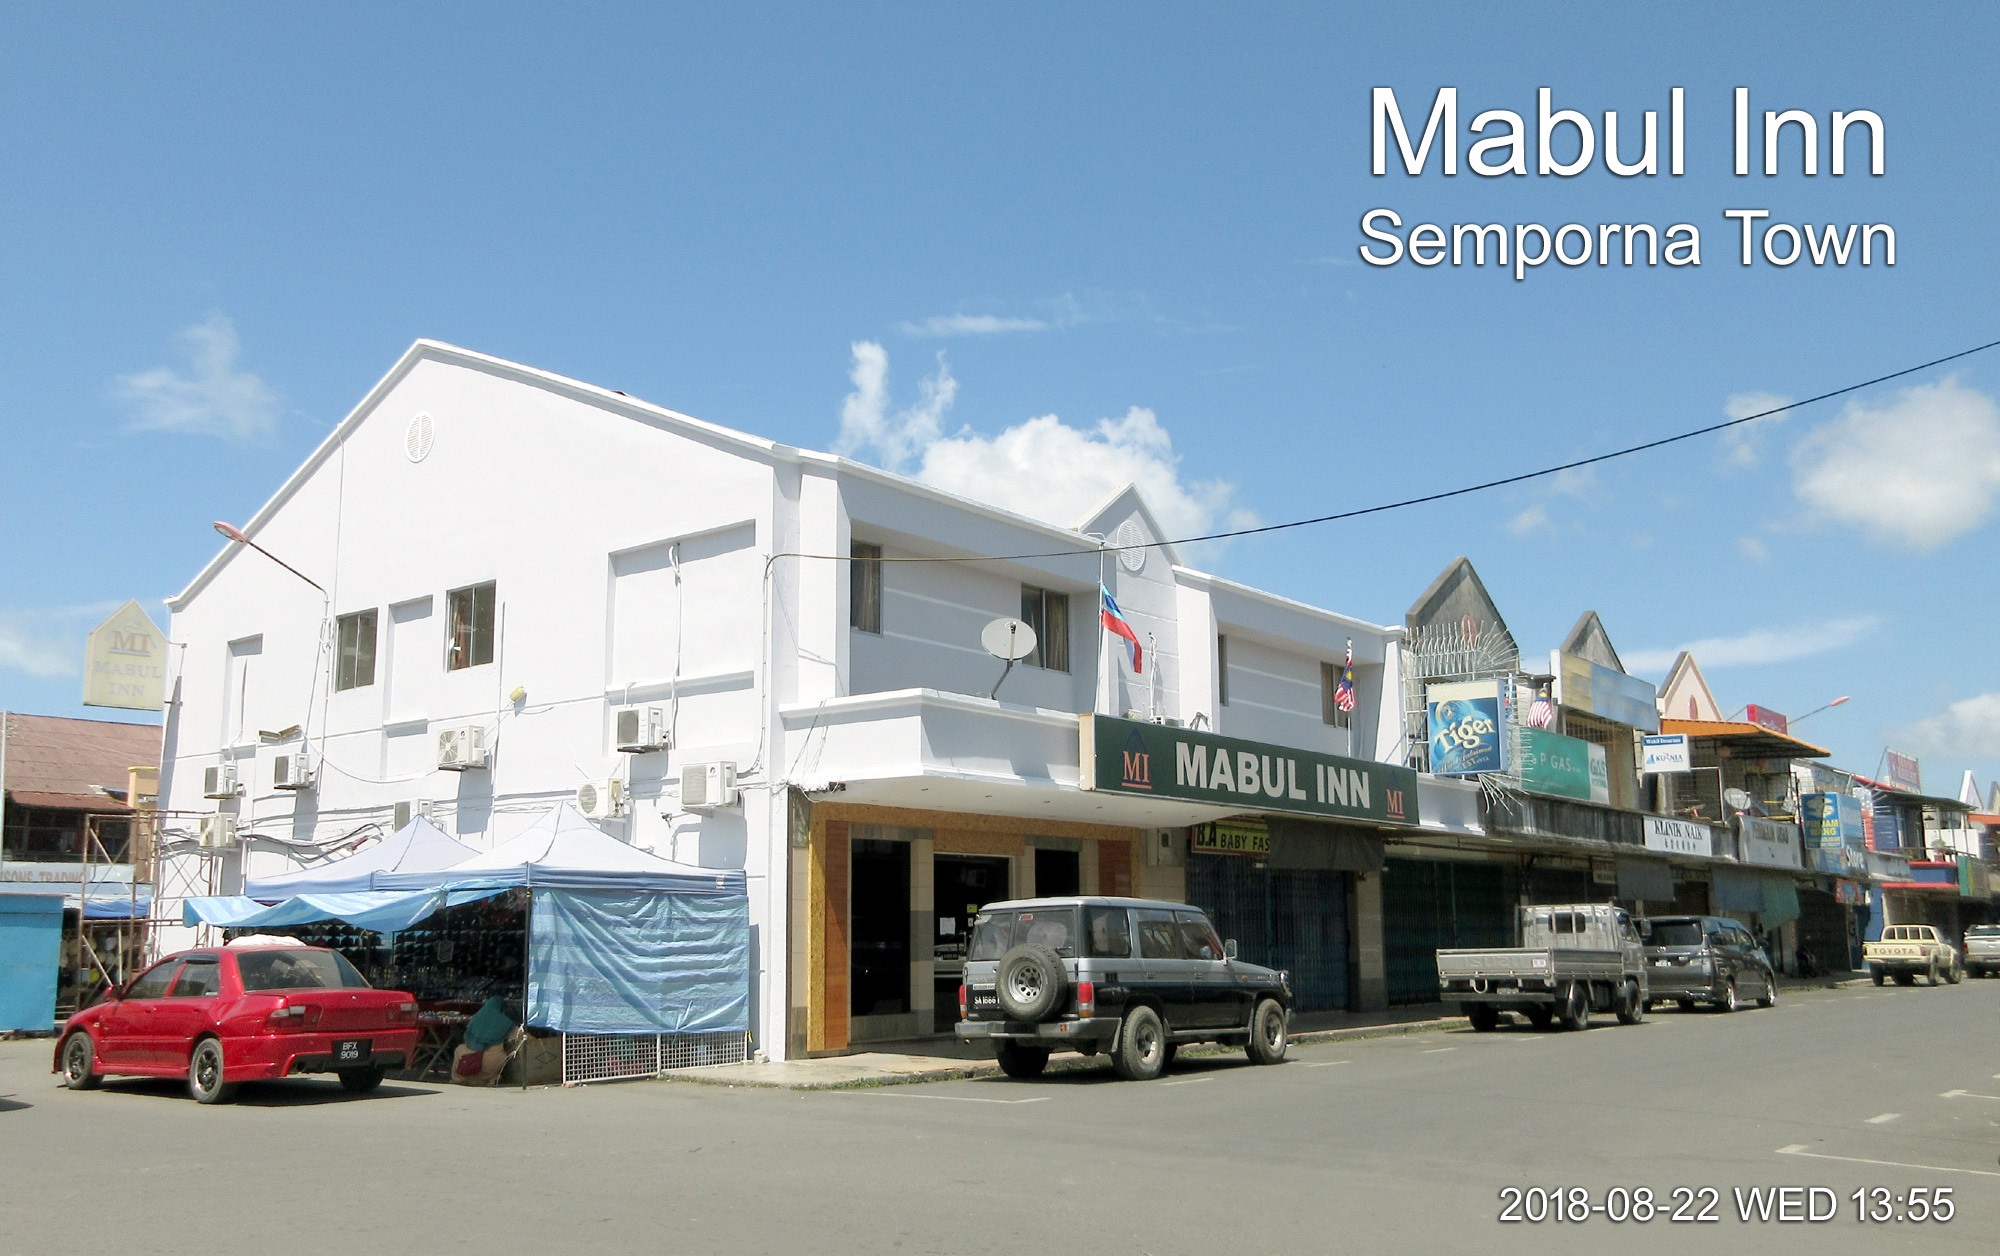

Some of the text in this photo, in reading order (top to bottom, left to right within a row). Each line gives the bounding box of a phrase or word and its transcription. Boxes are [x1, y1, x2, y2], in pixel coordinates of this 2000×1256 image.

[111, 631, 152, 652] MI
[95, 661, 162, 679] MABUL
[109, 682, 145, 697] INN
[1434, 715, 1496, 753] Tiger
[1550, 755, 1571, 772] GAS
[1655, 752, 1683, 762] KURNIA
[1122, 750, 1150, 784] MI
[1175, 741, 1371, 809] MABUL INN
[1386, 788, 1404, 815] MI
[1654, 820, 1683, 838] KLINIK
[1220, 833, 1248, 849] BABY
[1253, 836, 1270, 852] FAS
[1872, 947, 1915, 955] TOYOTA
[341, 1050, 359, 1059] 9019
[342, 1041, 358, 1050] BFX
